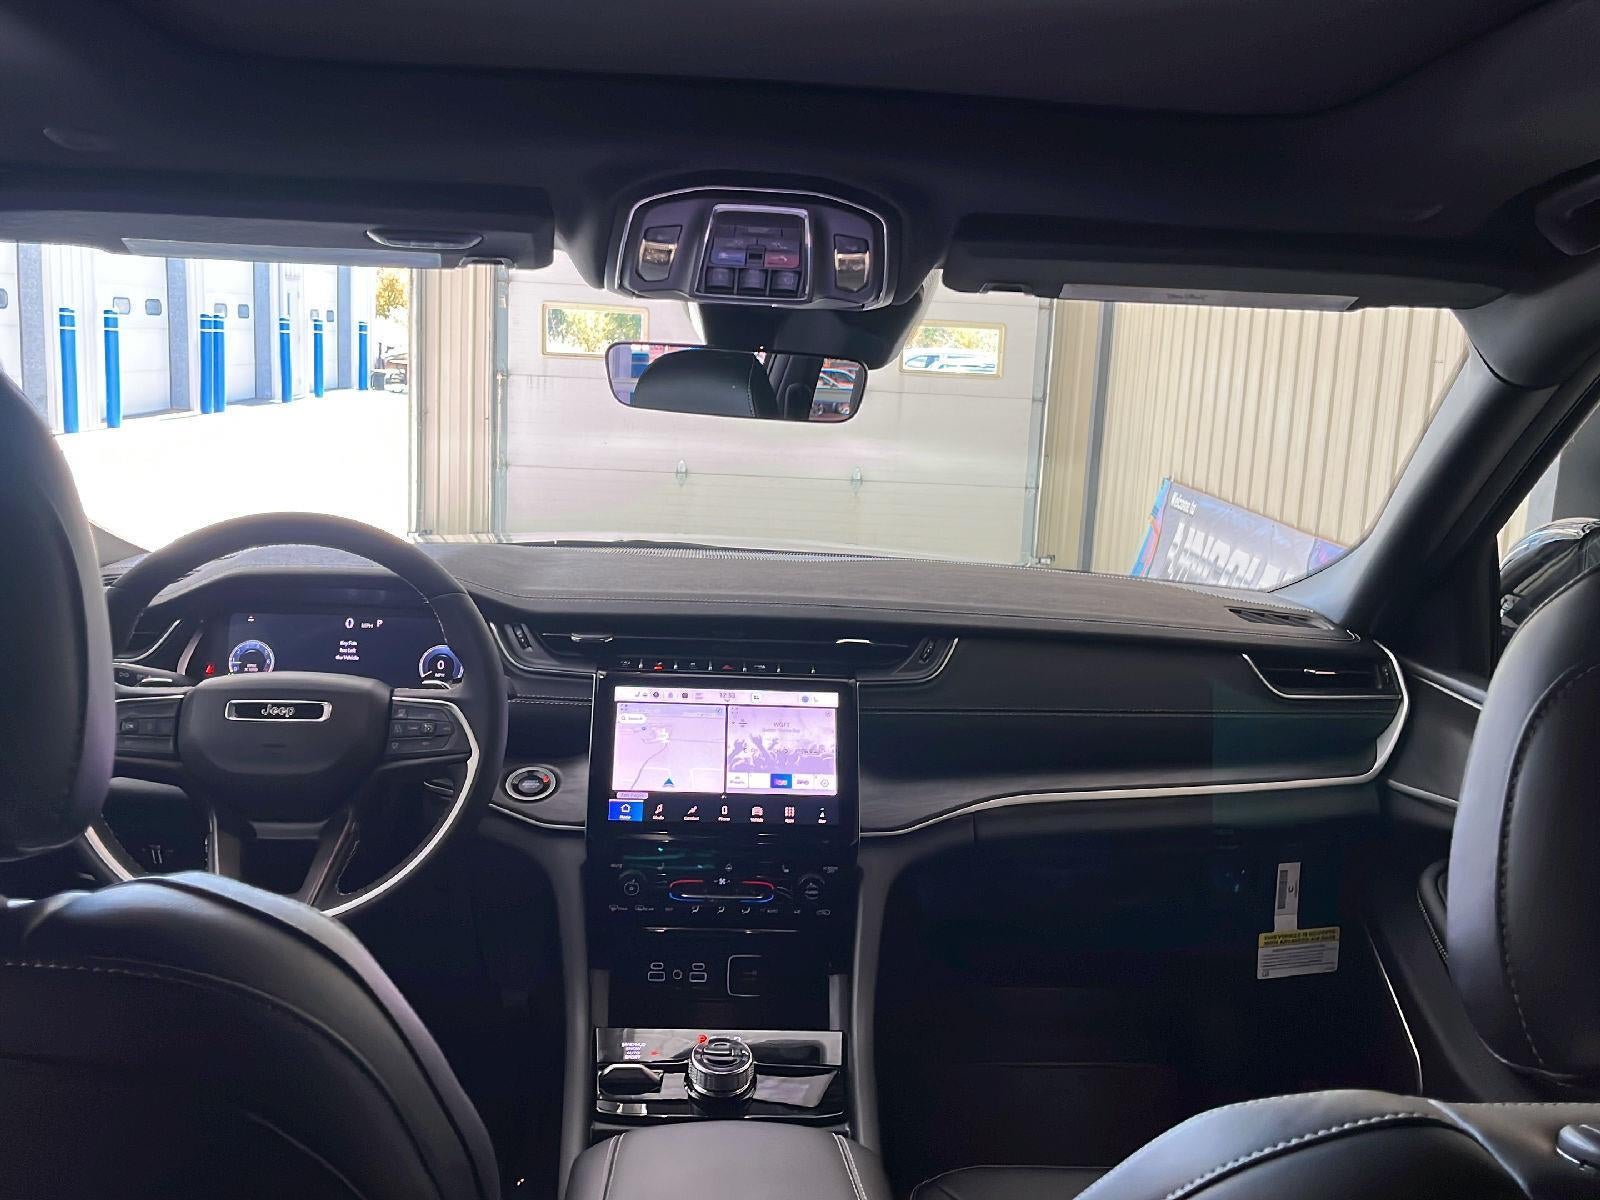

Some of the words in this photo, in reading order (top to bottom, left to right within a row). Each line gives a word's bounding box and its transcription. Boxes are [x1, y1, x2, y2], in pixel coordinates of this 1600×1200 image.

[345, 617, 354, 629] 0
[376, 619, 384, 628] P
[437, 660, 445, 670] 0
[261, 704, 296, 718] Jeep
